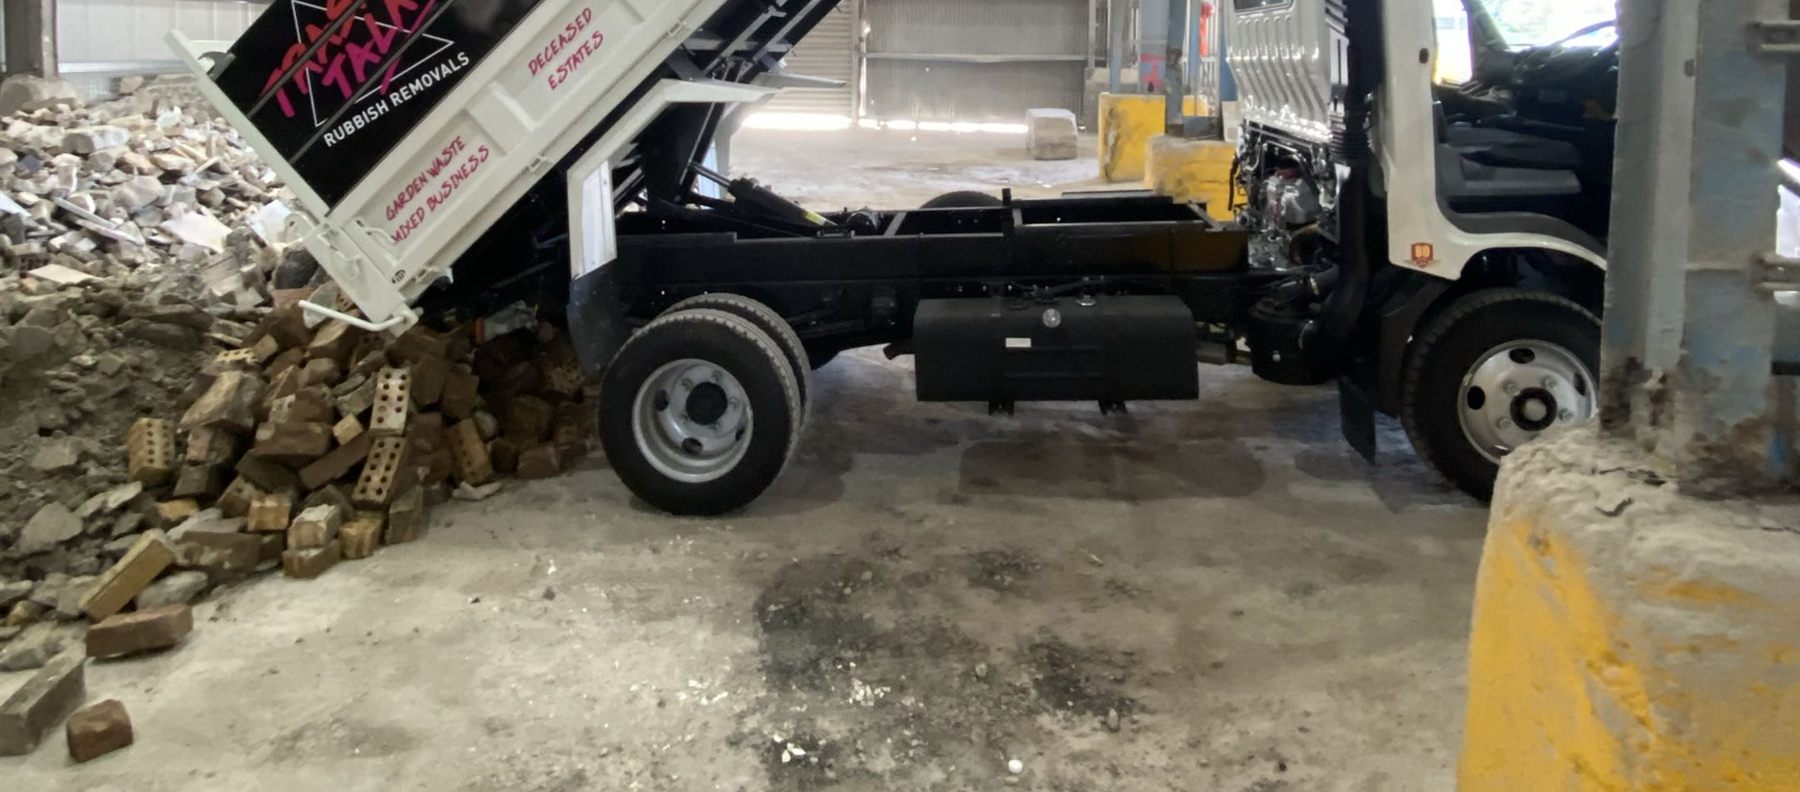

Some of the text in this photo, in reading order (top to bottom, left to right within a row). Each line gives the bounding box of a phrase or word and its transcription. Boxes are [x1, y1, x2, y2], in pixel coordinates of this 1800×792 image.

[528, 8, 591, 76] DECEASED
[548, 30, 603, 90] ESTATES
[323, 52, 470, 147] RUBBISH REMOVALS
[386, 135, 465, 220] GARDEN WASTE
[390, 145, 489, 243] MIXED BUSINESS
